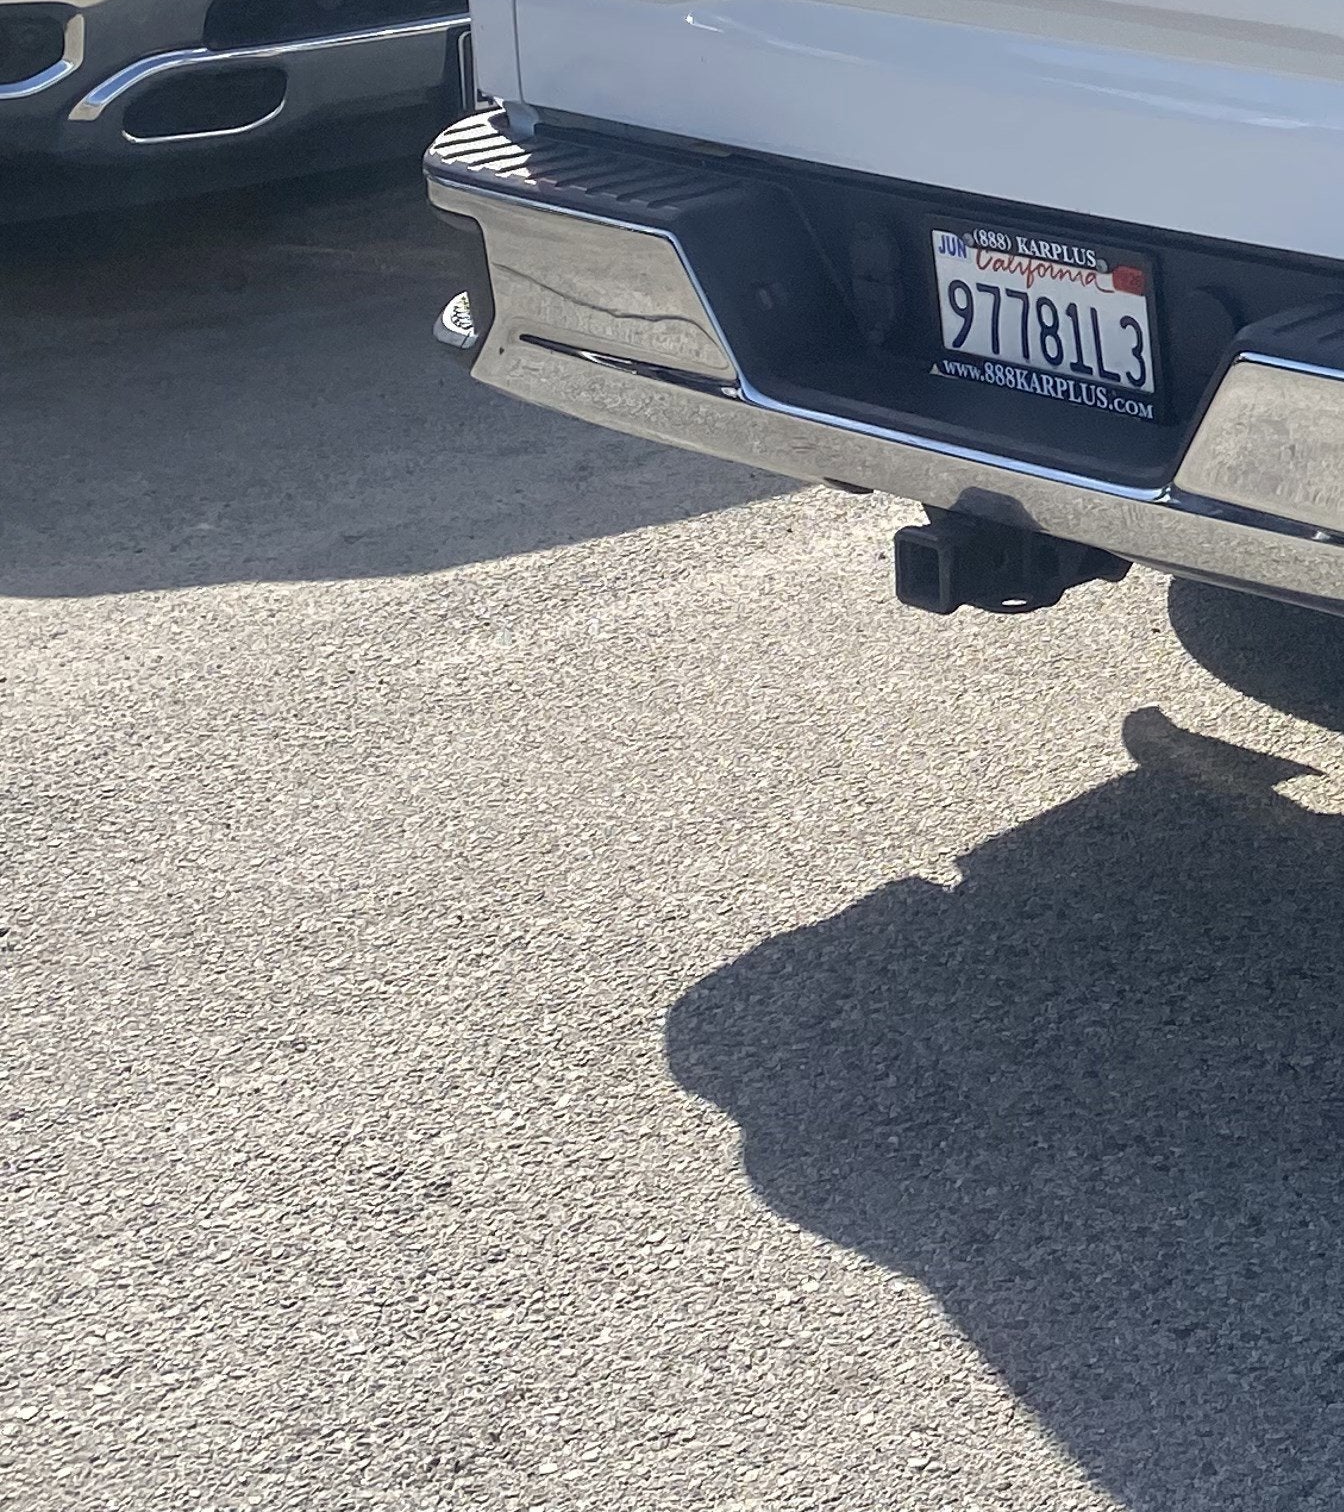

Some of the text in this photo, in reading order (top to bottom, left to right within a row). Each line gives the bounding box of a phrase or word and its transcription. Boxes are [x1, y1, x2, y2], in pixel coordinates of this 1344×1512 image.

[938, 234, 968, 259] JUN
[973, 228, 1097, 268] (888) KARPLUS
[975, 248, 1115, 293] California
[948, 279, 1147, 388] 97781L3
